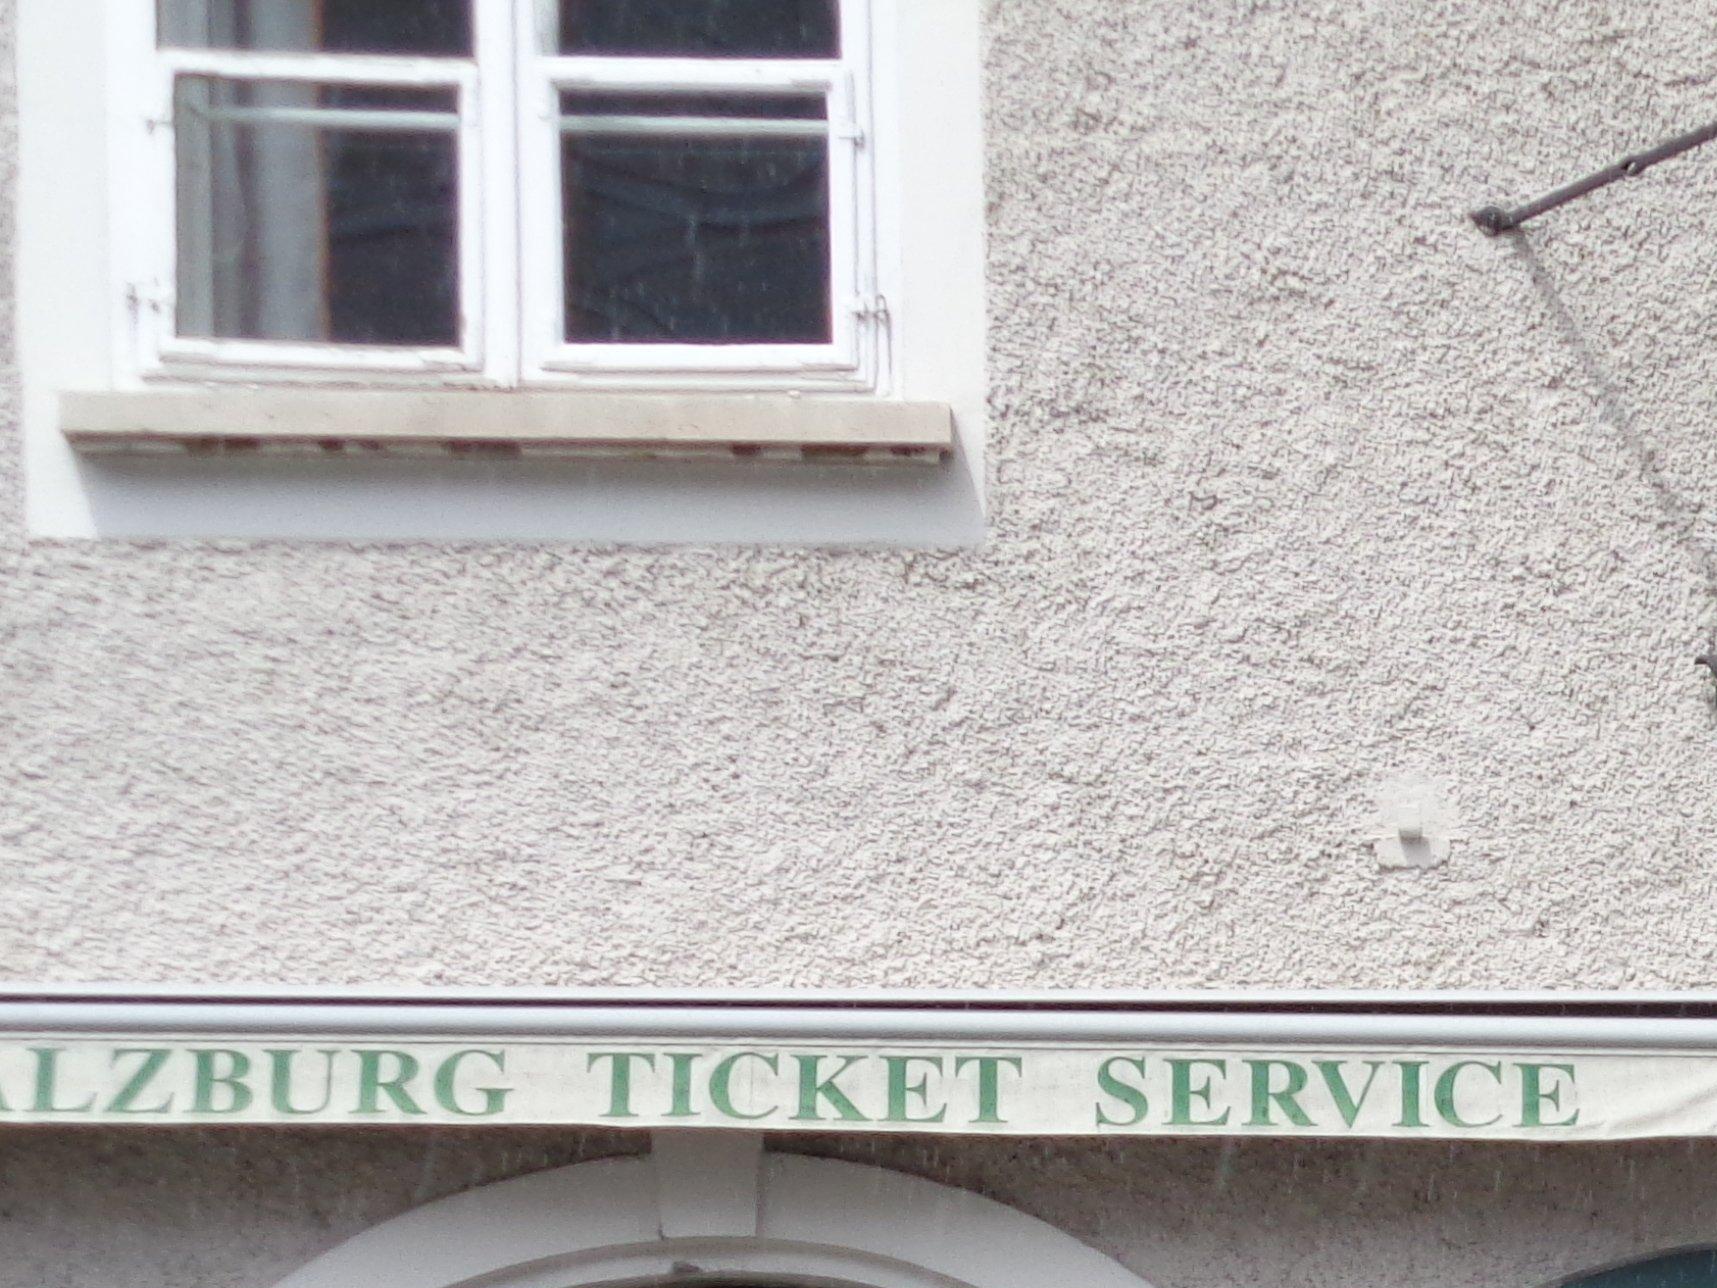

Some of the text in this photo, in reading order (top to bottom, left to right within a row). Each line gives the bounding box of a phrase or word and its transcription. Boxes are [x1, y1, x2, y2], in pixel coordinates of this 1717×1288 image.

[0, 1046, 1580, 1129] LZBURG TICKET SERVICE
